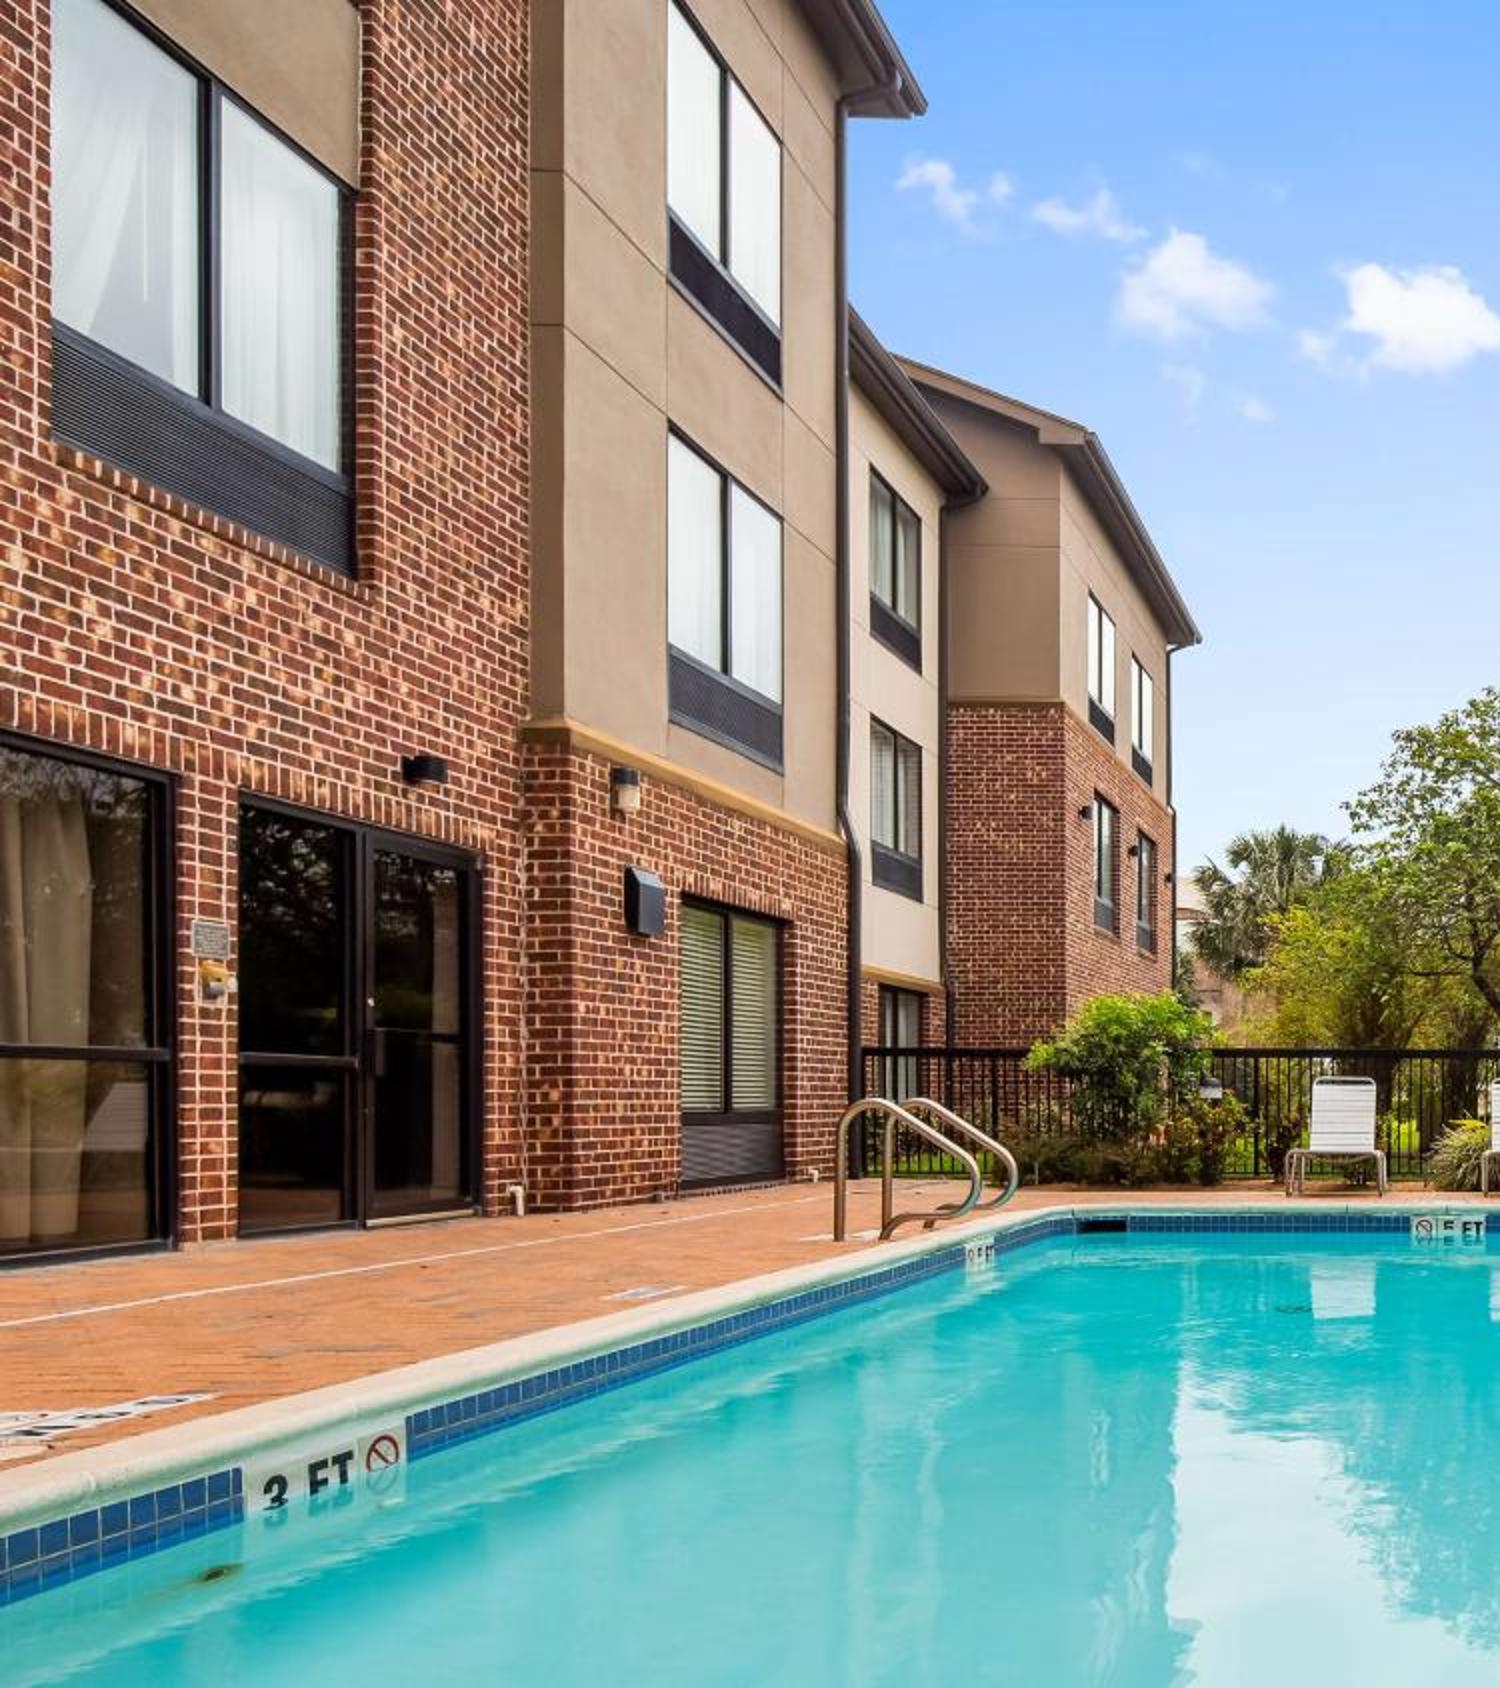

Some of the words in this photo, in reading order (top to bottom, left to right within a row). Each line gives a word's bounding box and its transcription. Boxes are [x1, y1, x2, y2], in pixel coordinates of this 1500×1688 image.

[1462, 1221, 1484, 1236] FT
[263, 1473, 288, 1511] 3
[308, 1450, 354, 1495] FT
